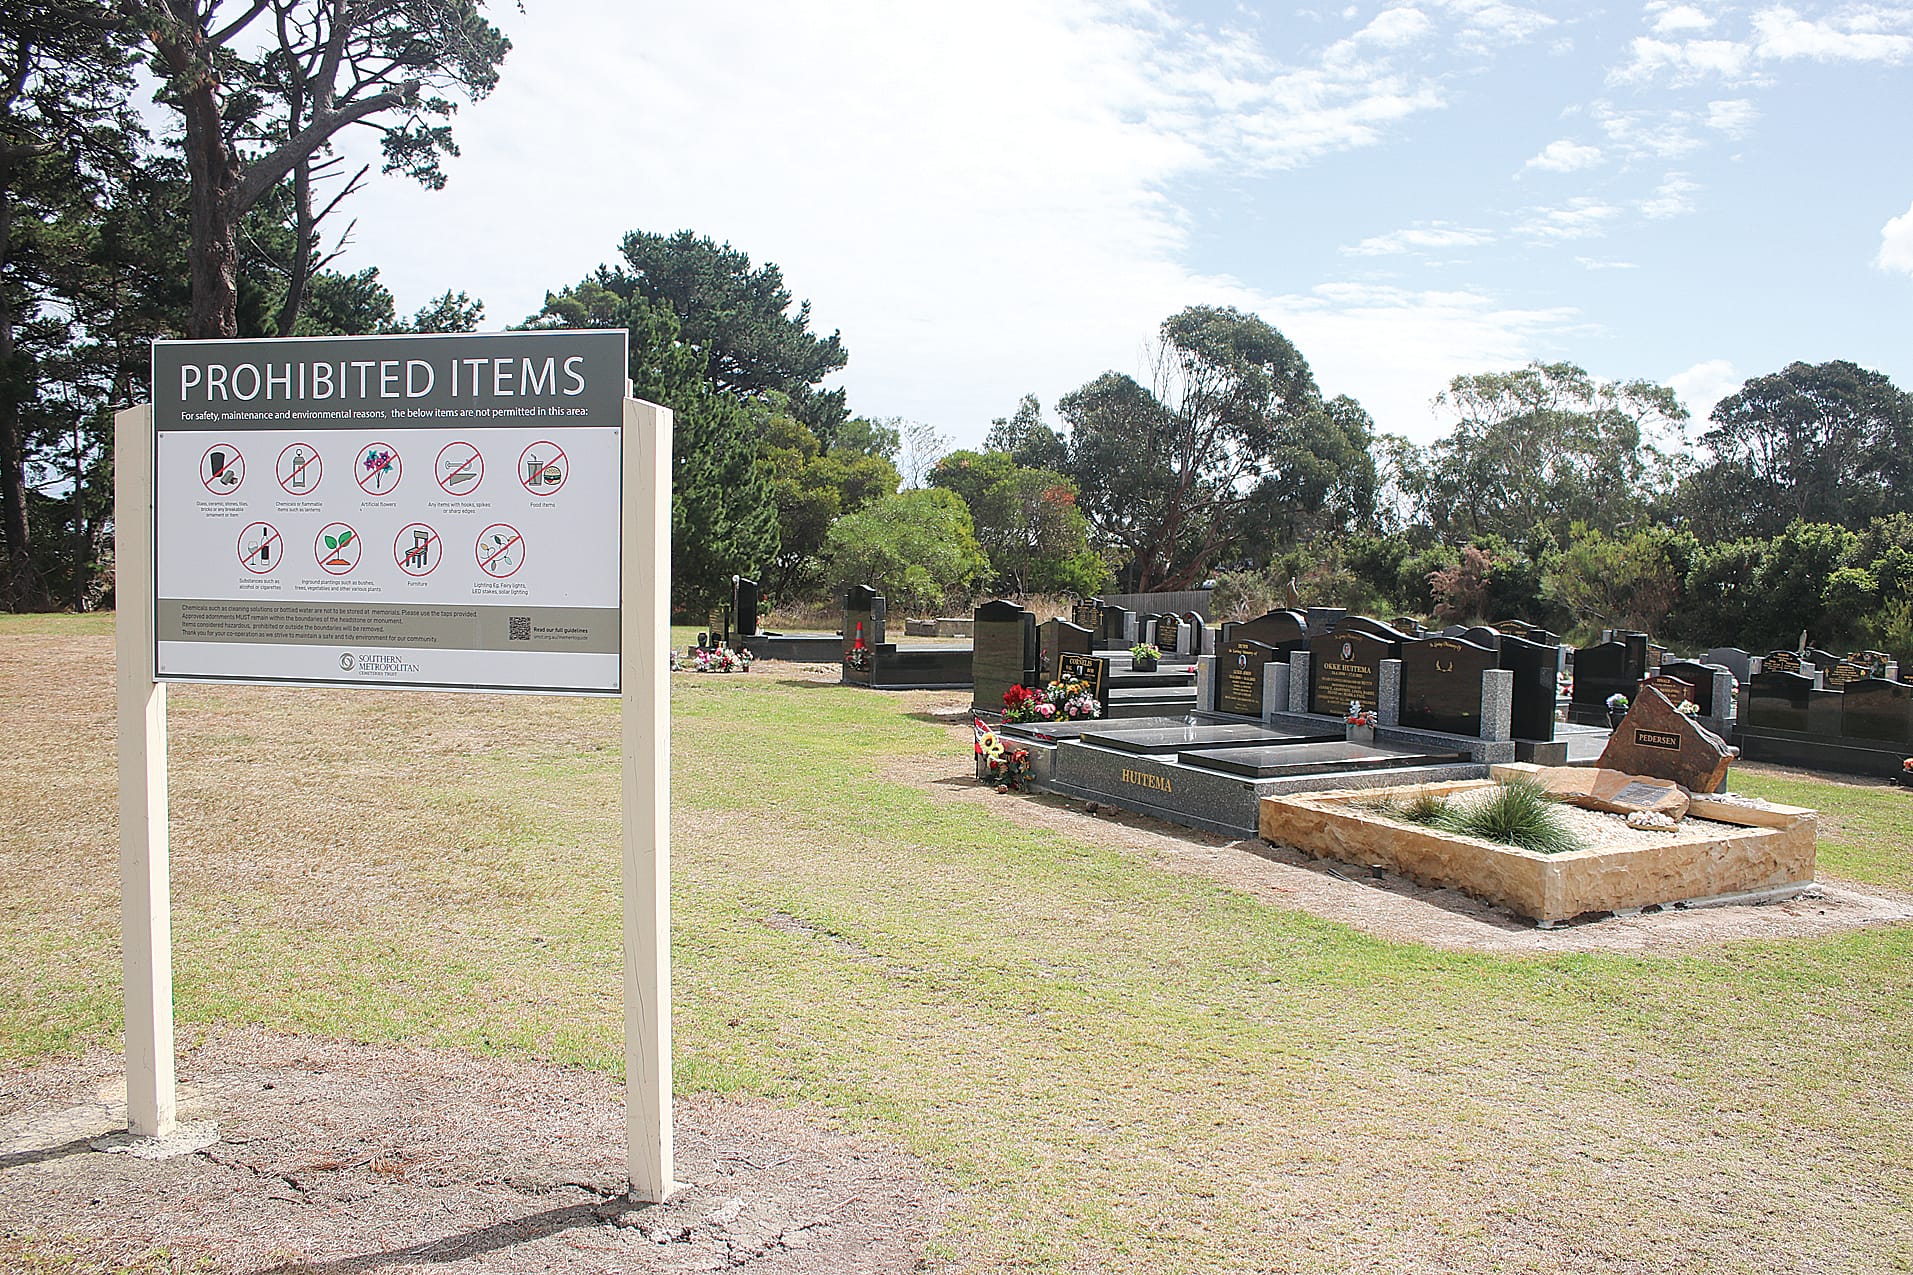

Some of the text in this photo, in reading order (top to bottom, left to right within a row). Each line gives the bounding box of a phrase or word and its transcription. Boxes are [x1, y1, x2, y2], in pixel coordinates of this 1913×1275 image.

[181, 356, 586, 401] PROHIBITED ITEMS
[182, 412, 193, 420] For
[196, 411, 220, 422] safety,
[222, 411, 273, 420] maintenance
[275, 410, 290, 419] and
[292, 409, 351, 419] environmental
[353, 410, 386, 419] reasons,
[391, 409, 405, 417] the
[407, 408, 433, 417] below
[435, 408, 458, 417] items
[476, 408, 490, 416] not
[492, 407, 535, 418] permitted
[538, 407, 546, 416] in
[549, 406, 564, 416] this
[358, 654, 402, 663] SOUTHERN
[359, 663, 419, 672] METROPOLITAN
[1324, 663, 1341, 671] OKKE
[1342, 664, 1371, 674] HUITEMA
[1640, 734, 1676, 744] PEDERSEN
[1122, 769, 1172, 792] HUITEMA
